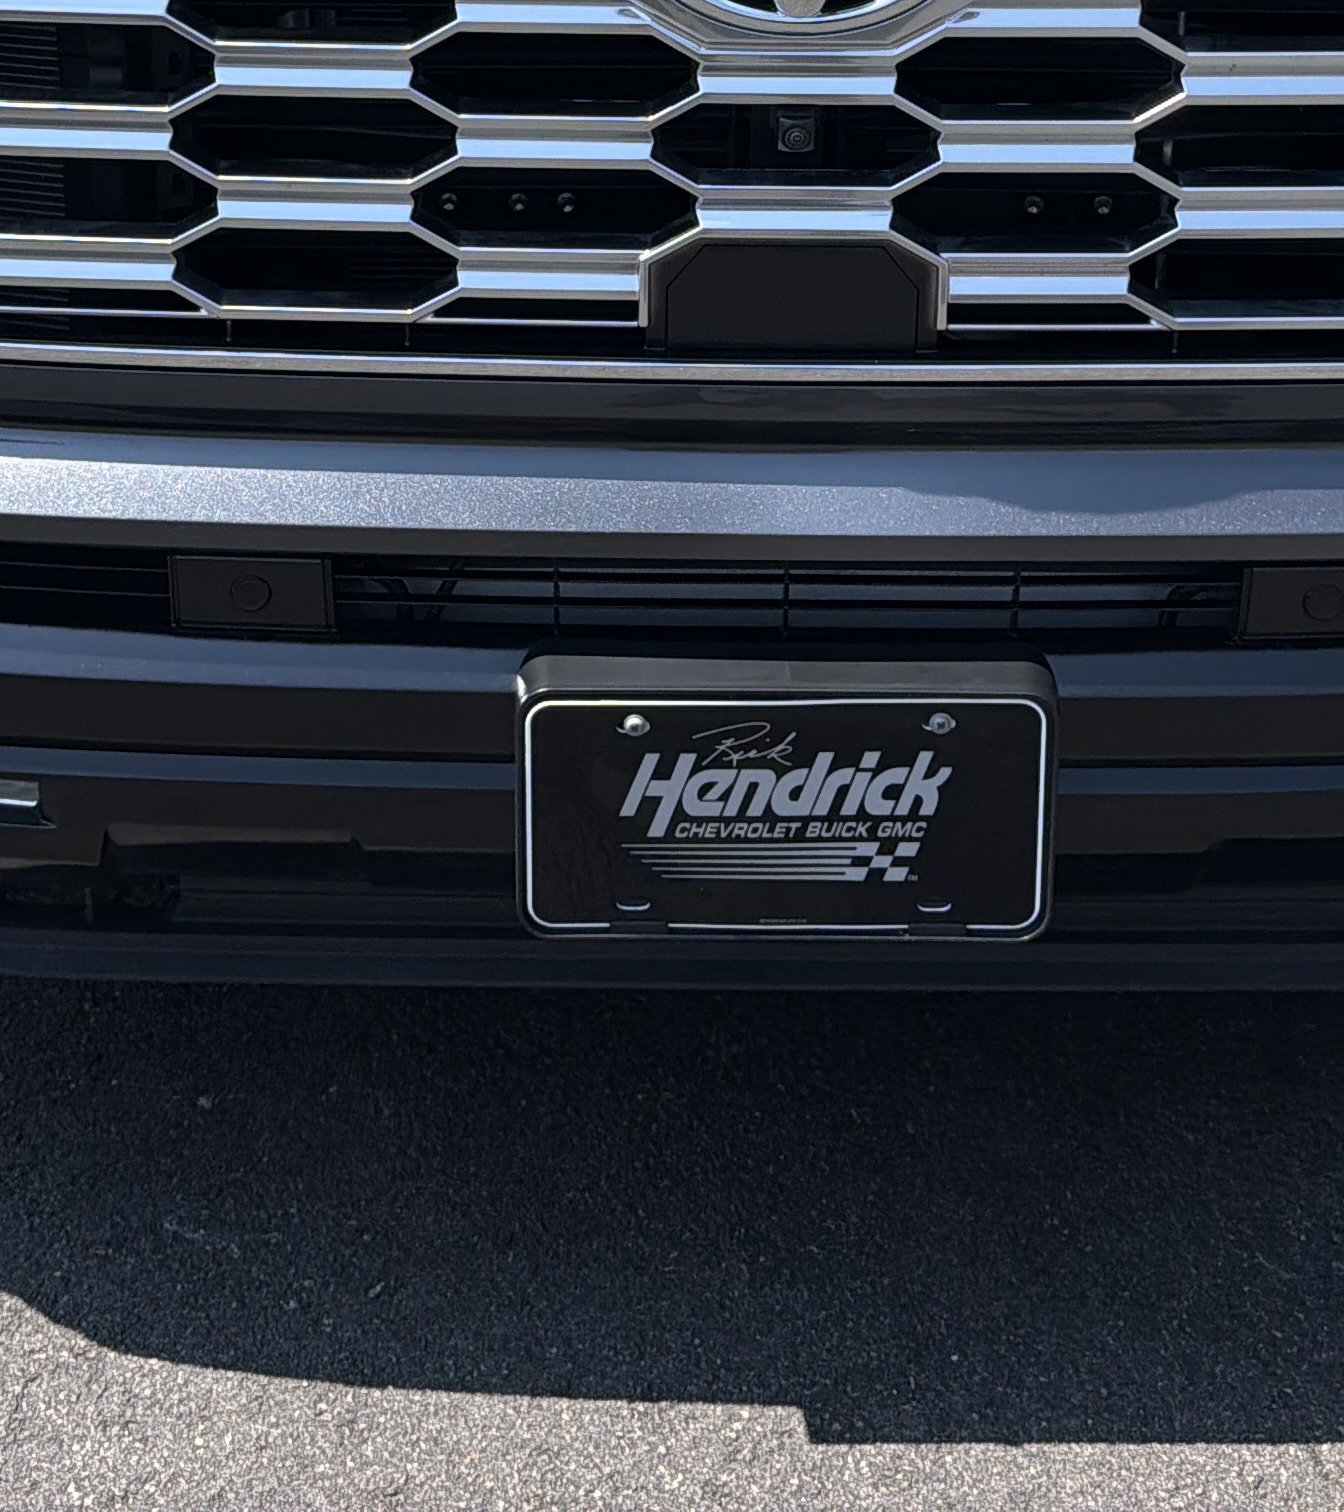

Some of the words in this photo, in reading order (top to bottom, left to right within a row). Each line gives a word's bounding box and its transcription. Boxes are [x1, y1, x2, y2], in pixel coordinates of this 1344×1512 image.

[619, 750, 952, 837] Hendrick
[674, 822, 799, 838] CHEVROLET
[804, 822, 869, 838] BUICK
[877, 821, 927, 838] GMC
